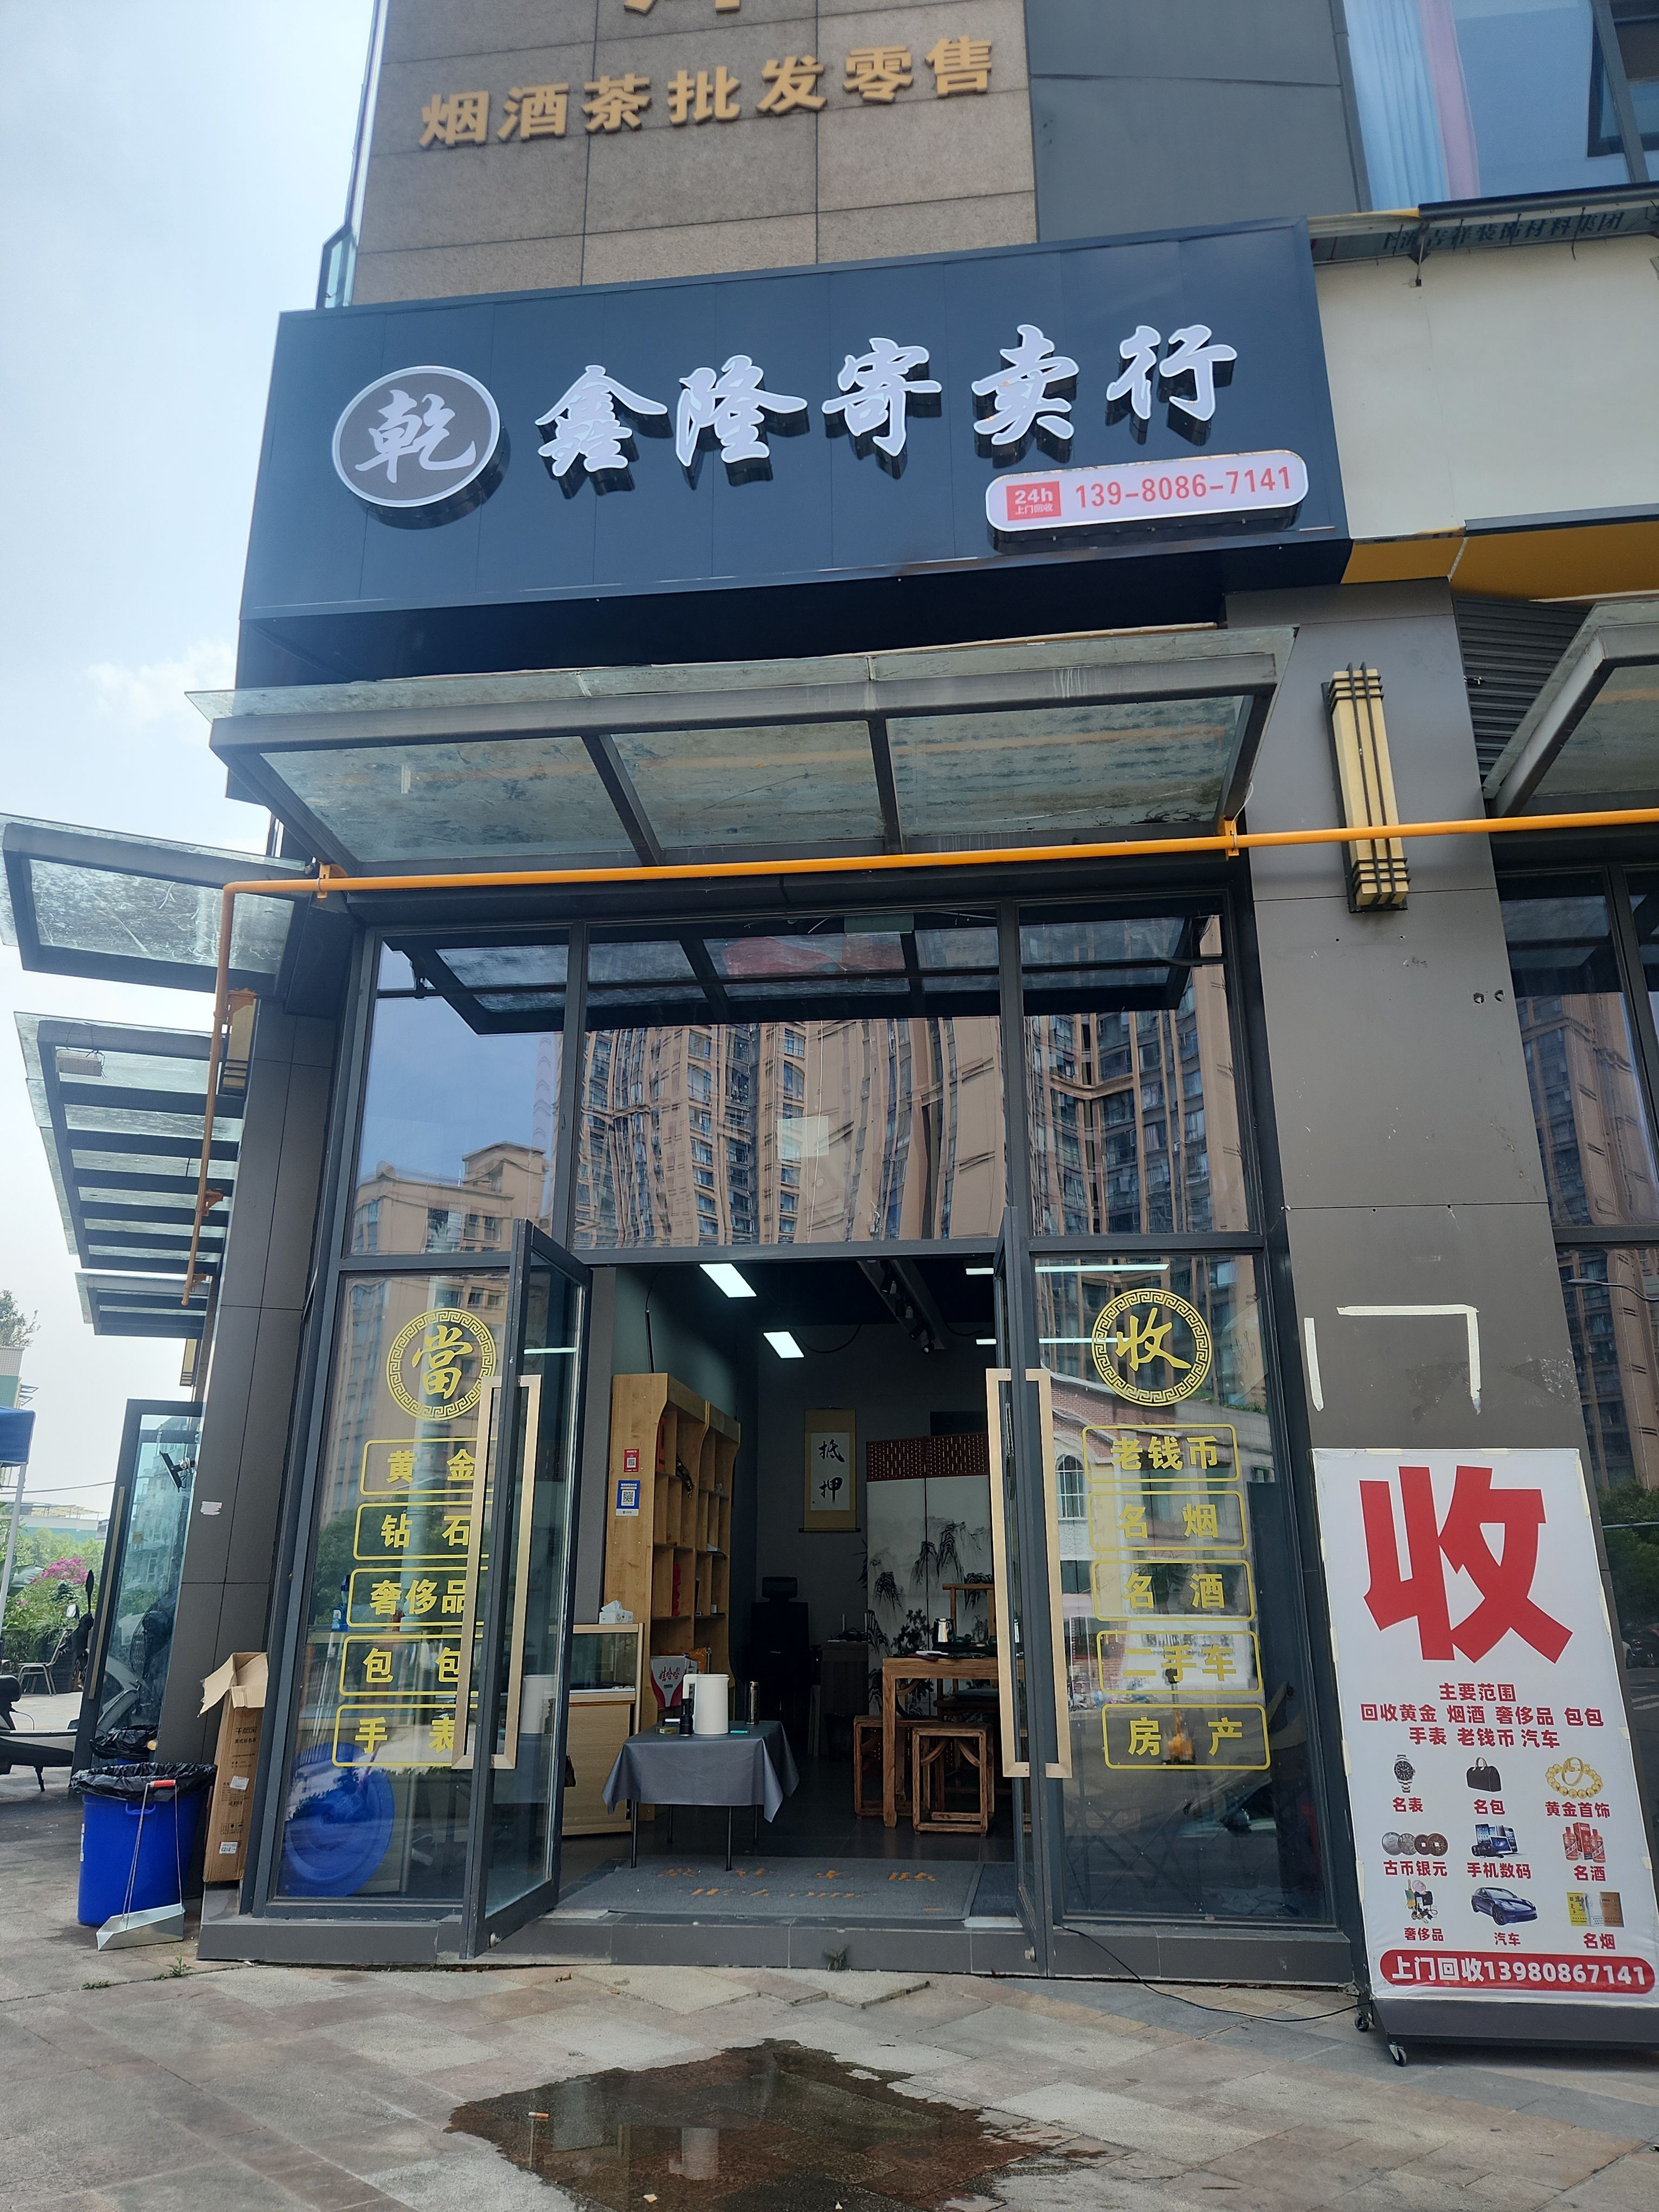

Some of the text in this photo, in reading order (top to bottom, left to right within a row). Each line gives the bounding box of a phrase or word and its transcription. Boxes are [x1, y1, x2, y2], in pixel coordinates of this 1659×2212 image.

[420, 36, 995, 149] 烟酒茶批发零售
[535, 324, 1238, 478] 鑫隆寄卖行
[355, 389, 477, 483] 乾
[1014, 487, 1053, 504] 24h
[1076, 466, 1291, 508] 139-8086-7141
[1015, 503, 1053, 515] 上门回收
[1115, 1307, 1192, 1372] 收
[411, 1324, 473, 1400] 當
[386, 1449, 476, 1483] 黄金
[1110, 1435, 1218, 1471] 老钱币
[381, 1513, 471, 1548] 钻石
[1117, 1503, 1218, 1539] 名烟
[1359, 1465, 1573, 1664] 收
[369, 1579, 467, 1616] 奢侈品
[1123, 1572, 1225, 1609] 名酒
[363, 1647, 461, 1683] 包包
[1123, 1644, 1237, 1681] 二手车
[1439, 1682, 1517, 1702] 主要范围
[1360, 1703, 1604, 1727] 回收黄金 烟酒 奢侈品 包包
[355, 1716, 455, 1754] 手表
[1128, 1716, 1243, 1756] 房产
[1409, 1727, 1560, 1749] 手表 老钱币 汽车
[1392, 1797, 1424, 1813] 名表
[1474, 1799, 1506, 1815] 名包
[1545, 1801, 1610, 1819] 黄金首饰
[1383, 1860, 1448, 1877] 古币银元
[1467, 1862, 1532, 1880] 手机数码
[1574, 1865, 1606, 1882] 名酒
[1404, 1927, 1444, 1942] 奢侈品
[1494, 1932, 1521, 1946] 汽车
[1583, 1933, 1616, 1950] 名烟
[1392, 1956, 1645, 1985] 上门回收13980867141
